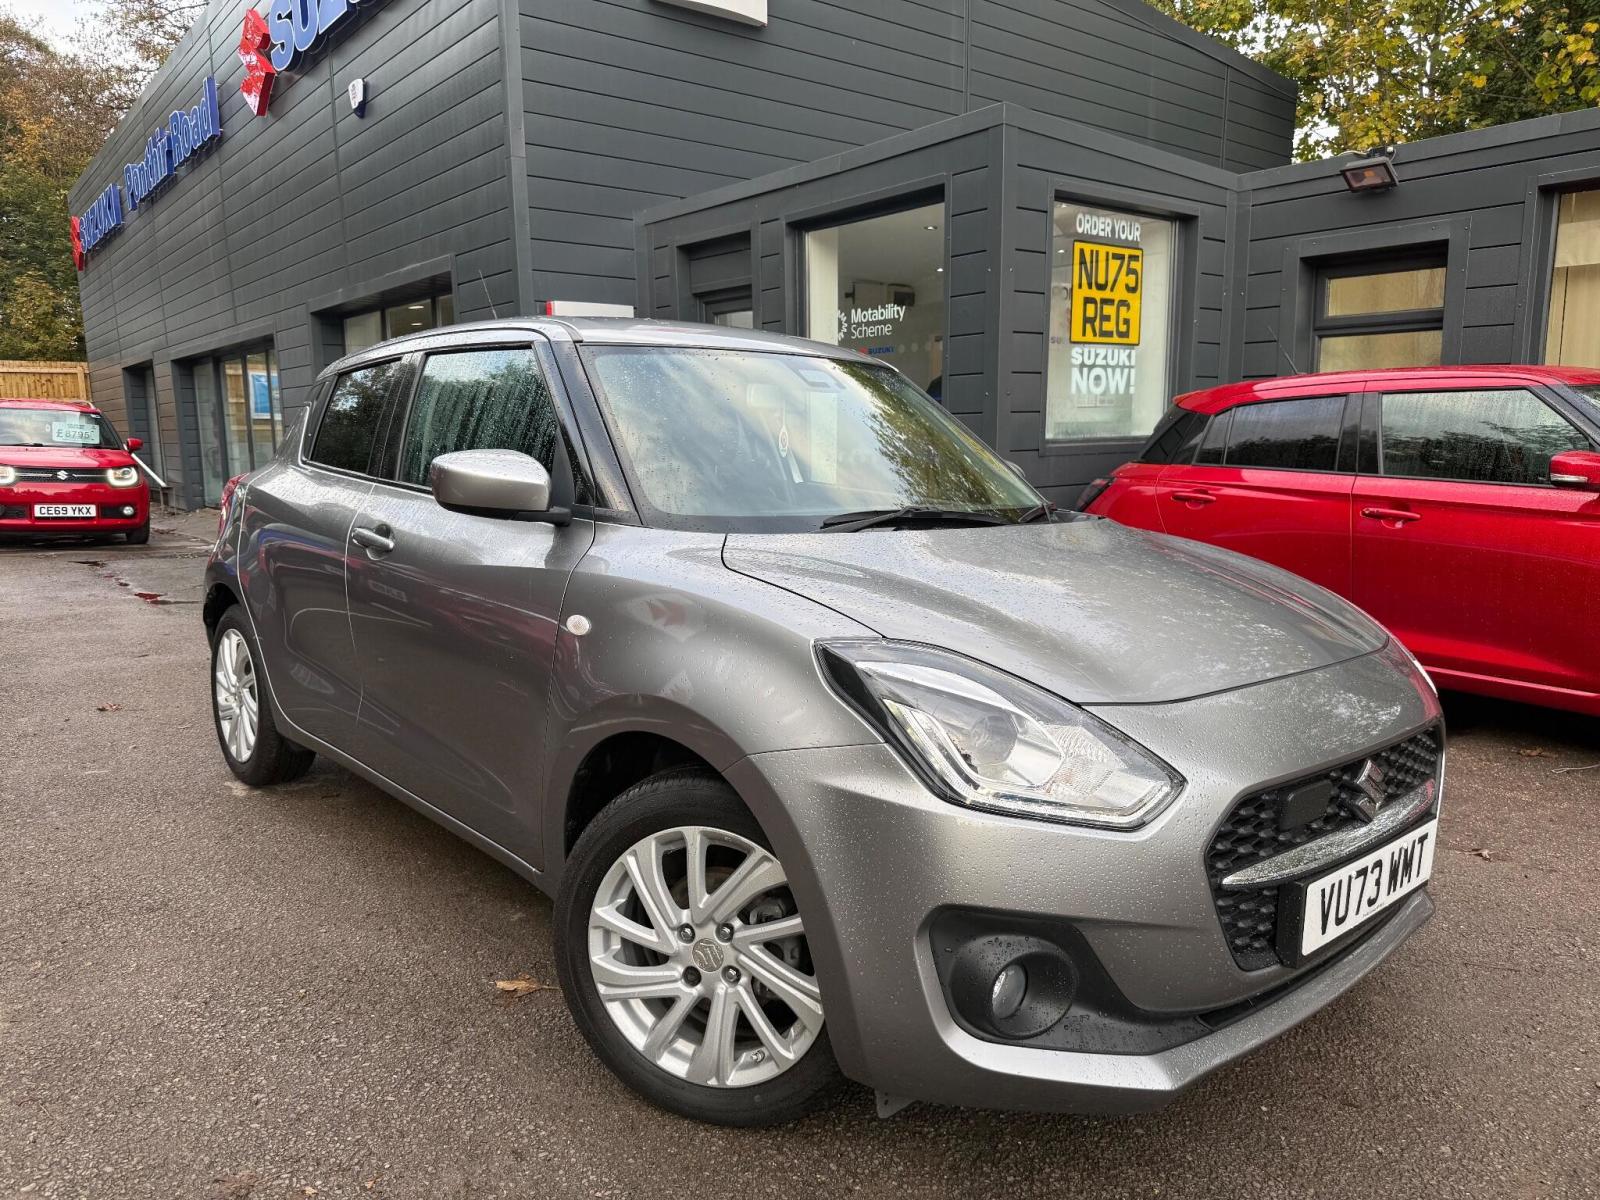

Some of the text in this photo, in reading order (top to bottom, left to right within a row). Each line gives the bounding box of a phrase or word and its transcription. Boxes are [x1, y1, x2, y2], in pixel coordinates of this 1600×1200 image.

[79, 76, 220, 254] SUZUKI Ponthir Road
[1076, 213, 1141, 242] ORDER YOUR
[1078, 248, 1140, 294] NU75
[851, 303, 906, 323] Motability
[1082, 297, 1131, 339] REG
[851, 323, 893, 339] Scheme
[868, 346, 895, 355] SUZUKI
[1071, 347, 1136, 366] SUZUKI
[1071, 367, 1136, 395] NOW!
[39, 506, 92, 515] CE69 YKX
[1320, 832, 1429, 935] VU73 WMT
